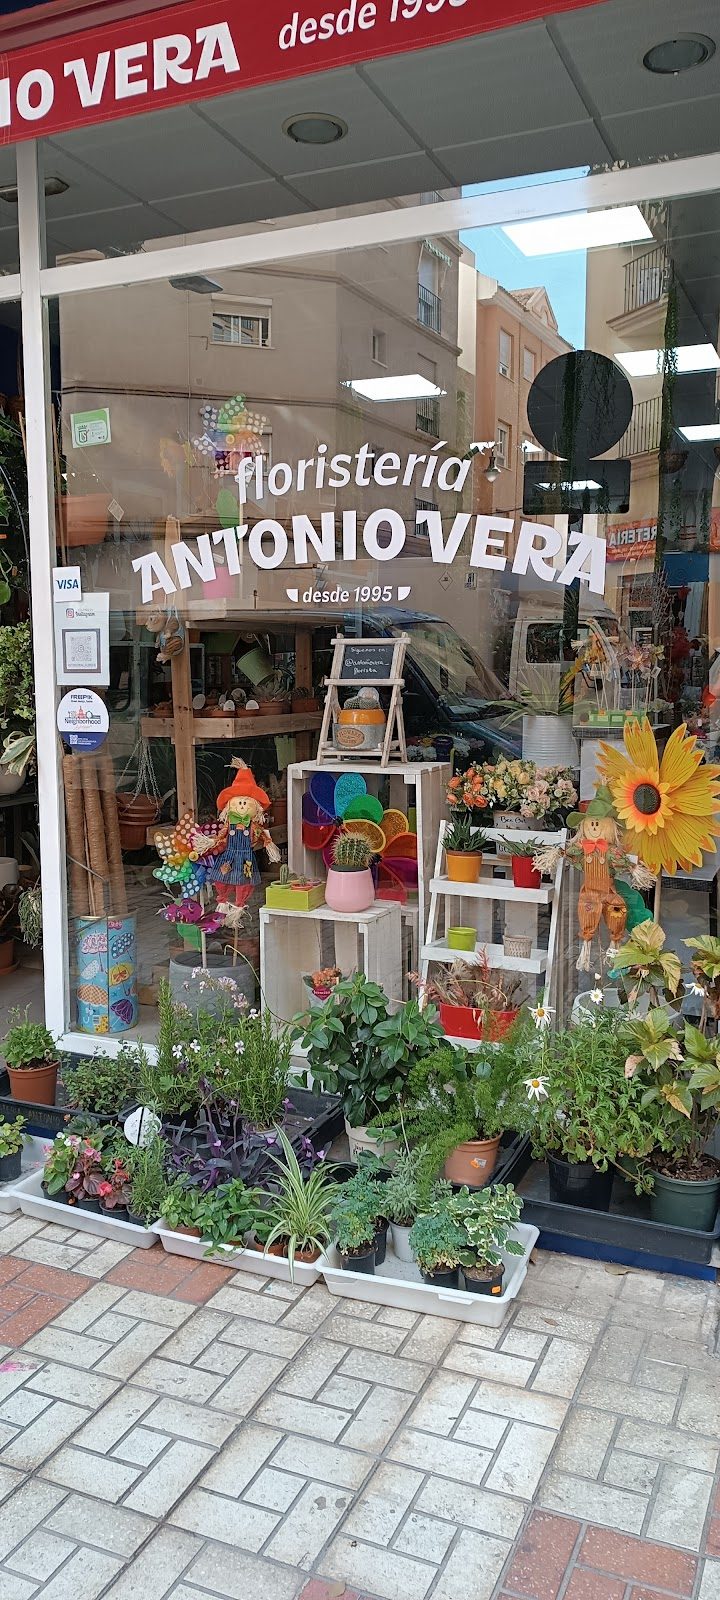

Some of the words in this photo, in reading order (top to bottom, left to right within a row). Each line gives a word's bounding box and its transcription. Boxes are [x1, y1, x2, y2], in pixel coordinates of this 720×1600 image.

[278, 0, 377, 50] desde
[64, 21, 241, 108] VERA
[234, 441, 471, 504] floristería
[131, 508, 407, 604] ANTONIO
[415, 510, 607, 596] VERA
[56, 579, 79, 590] VISA
[302, 586, 350, 603] desde
[353, 585, 393, 602] 1995
